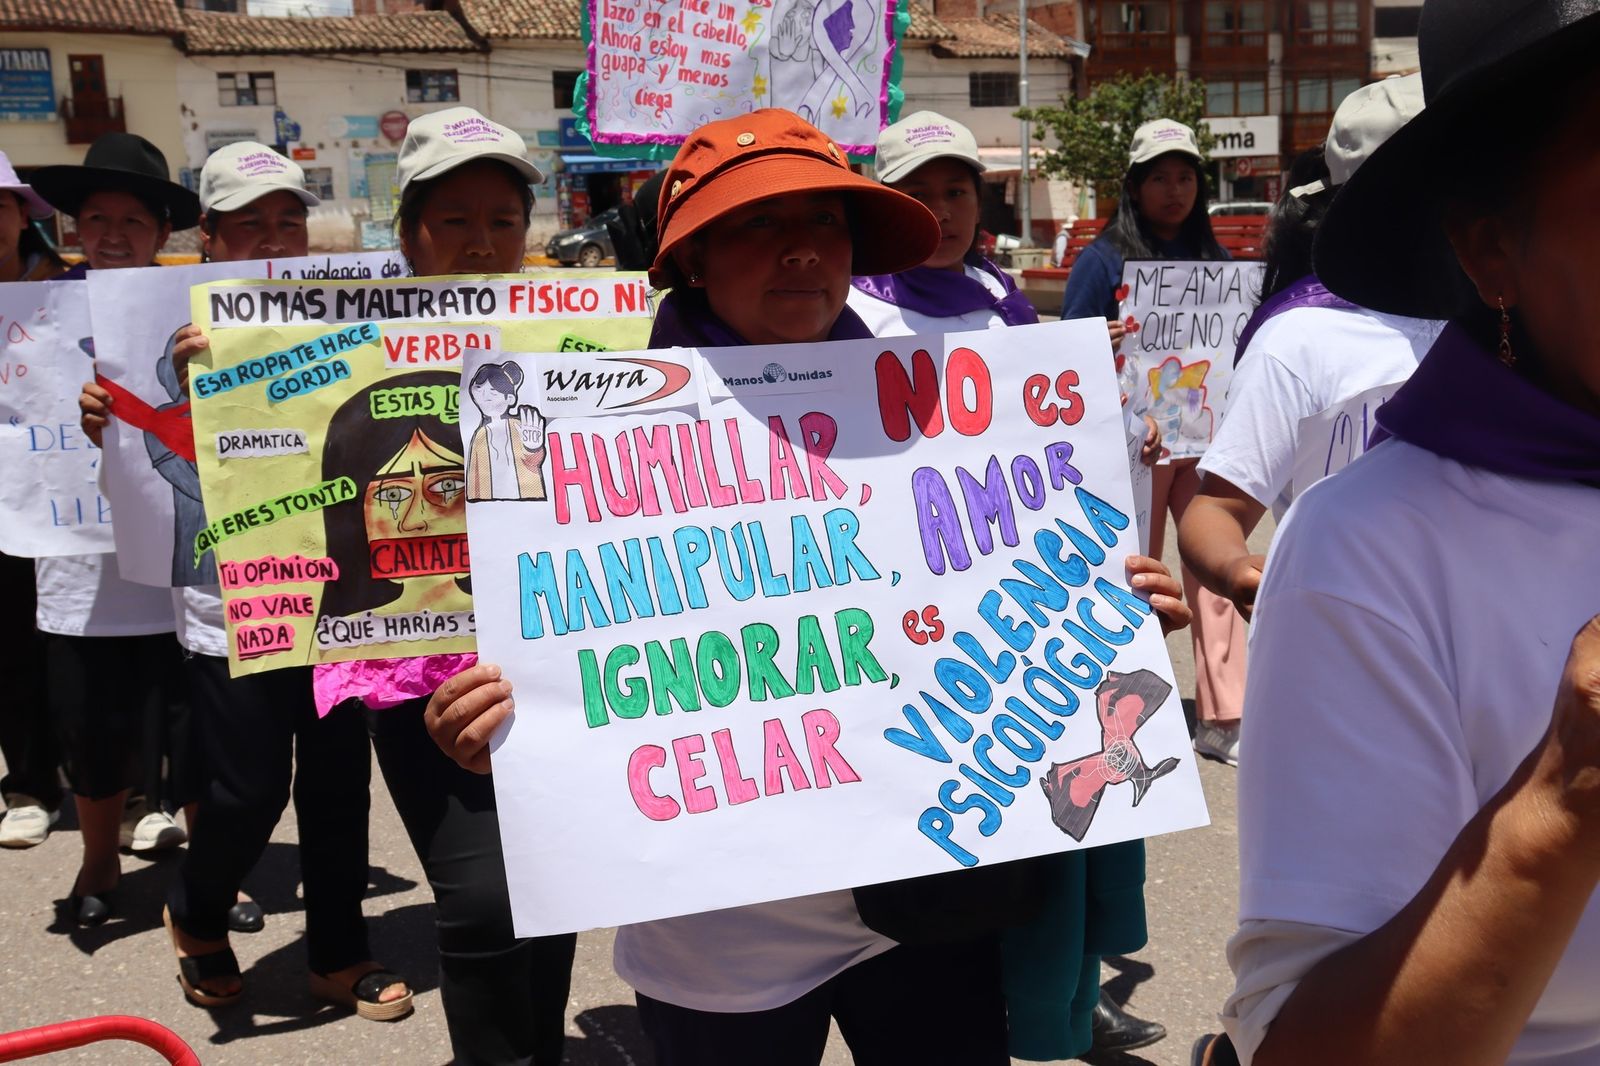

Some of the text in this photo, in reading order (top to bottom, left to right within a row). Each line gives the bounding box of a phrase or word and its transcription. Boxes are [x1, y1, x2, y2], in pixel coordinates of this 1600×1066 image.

[601, 21, 731, 69] Ahora estoy mas
[643, 12, 662, 29] en
[668, 10, 684, 33] el
[693, 19, 749, 51] cabello,
[0, 51, 49, 70] TARIA
[601, 53, 729, 88] guapa y menos
[301, 257, 372, 279] violencia
[1134, 266, 1175, 307] ME
[1179, 265, 1242, 306] AMA
[212, 292, 255, 322] NO
[260, 286, 327, 323] MÁS
[336, 286, 497, 320] MALTRATO
[560, 336, 607, 352] EST
[1141, 311, 1185, 352] QUE
[1191, 312, 1224, 349] NO
[195, 324, 373, 397] ESA ROPA TE HACE
[269, 359, 349, 400] GORDA
[722, 368, 833, 387] Manos Unidas
[373, 391, 435, 415] ESTAS
[546, 394, 579, 402] Asociación
[875, 347, 1085, 442] NO es
[219, 432, 304, 454] DRAMATICA
[522, 429, 541, 442] STOP
[548, 411, 872, 525] HUMILLAR,
[222, 504, 275, 535] ERES
[276, 479, 355, 515] TONTA
[912, 441, 1083, 576] AMOR
[371, 537, 471, 575] CALLATE
[517, 507, 901, 640] MANIPULAR,
[229, 596, 314, 619] NO VALE
[884, 486, 1129, 763] VIOLENCIA
[902, 604, 945, 646] es
[237, 625, 289, 652] NADA
[577, 607, 900, 729] IGNORAR,
[917, 576, 1152, 868] PSICOLÓGICA
[627, 708, 862, 822] CELAR
